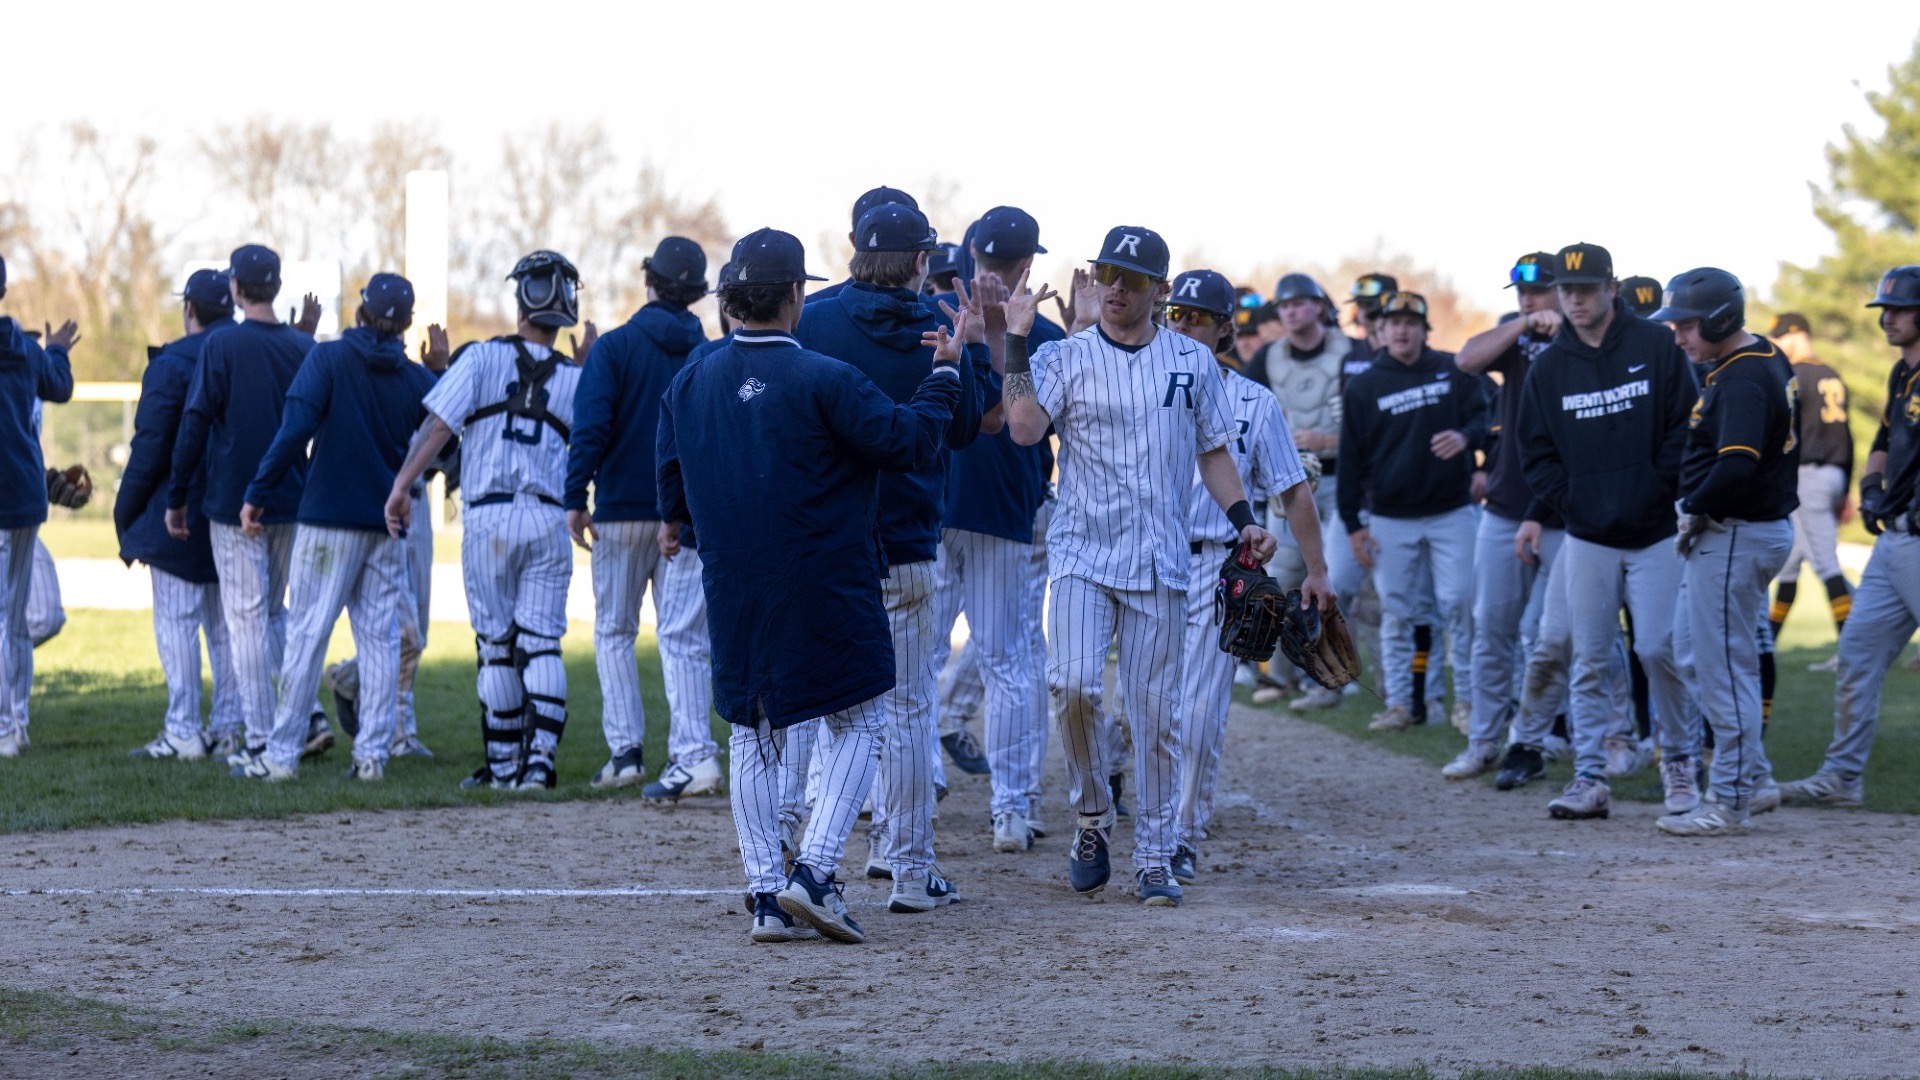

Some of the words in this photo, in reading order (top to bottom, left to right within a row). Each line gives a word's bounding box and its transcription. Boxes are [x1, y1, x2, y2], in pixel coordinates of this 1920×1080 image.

[1113, 233, 1142, 258] R
[1565, 252, 1583, 271] W
[1177, 277, 1202, 299] R
[1635, 287, 1655, 304] W
[1159, 371, 1195, 411] R
